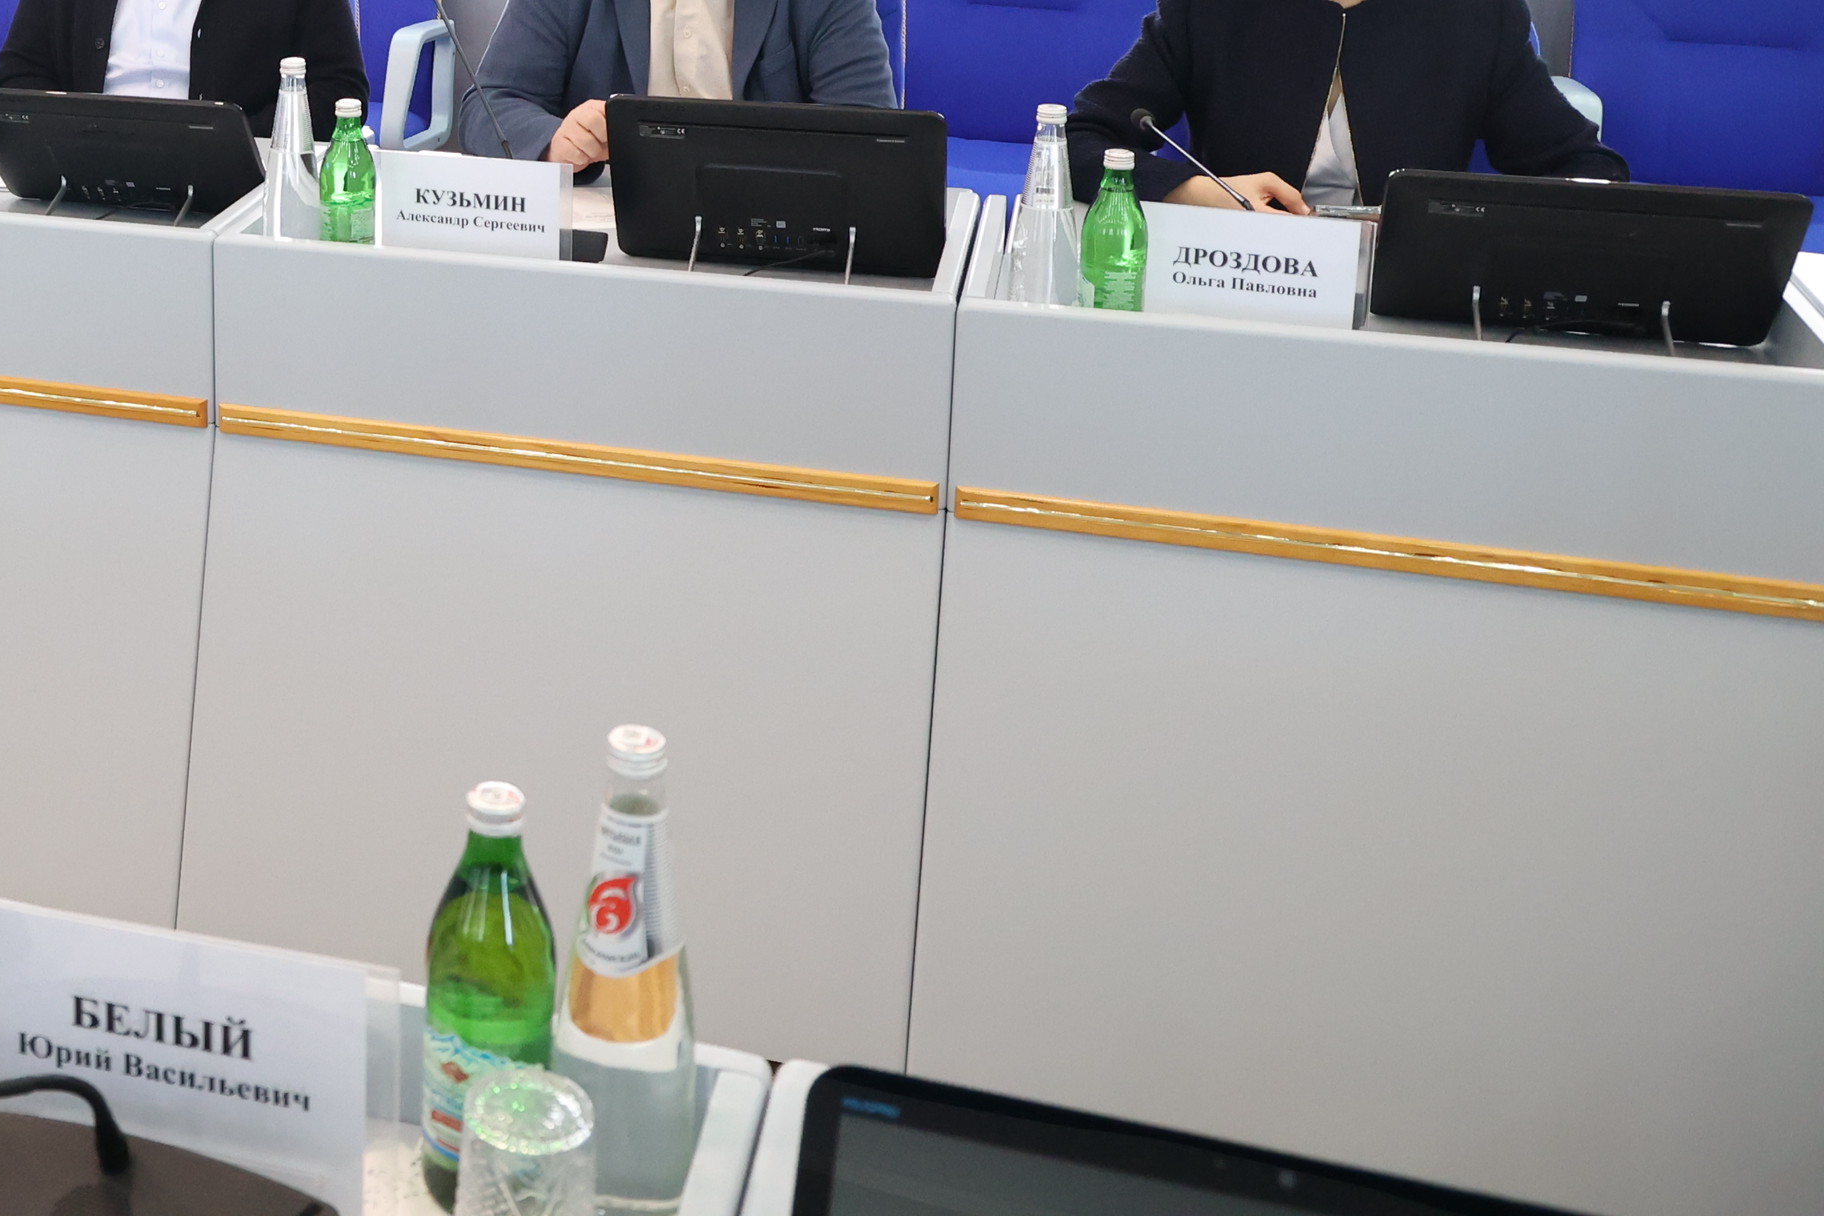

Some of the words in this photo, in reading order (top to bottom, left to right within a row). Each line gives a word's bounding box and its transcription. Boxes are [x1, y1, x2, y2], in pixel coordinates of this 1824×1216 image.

[415, 187, 527, 213] КУЗЬМИН
[396, 209, 469, 229] Александр
[473, 216, 546, 234] Сергеевич
[1172, 246, 1319, 278] ДРОЗДОВА
[1172, 271, 1226, 289] Ольга
[1231, 277, 1318, 298] Павловна
[71, 994, 254, 1062] БЕЛЫЙ
[18, 1032, 113, 1072] Юрий
[123, 1052, 312, 1112] Васильевич
